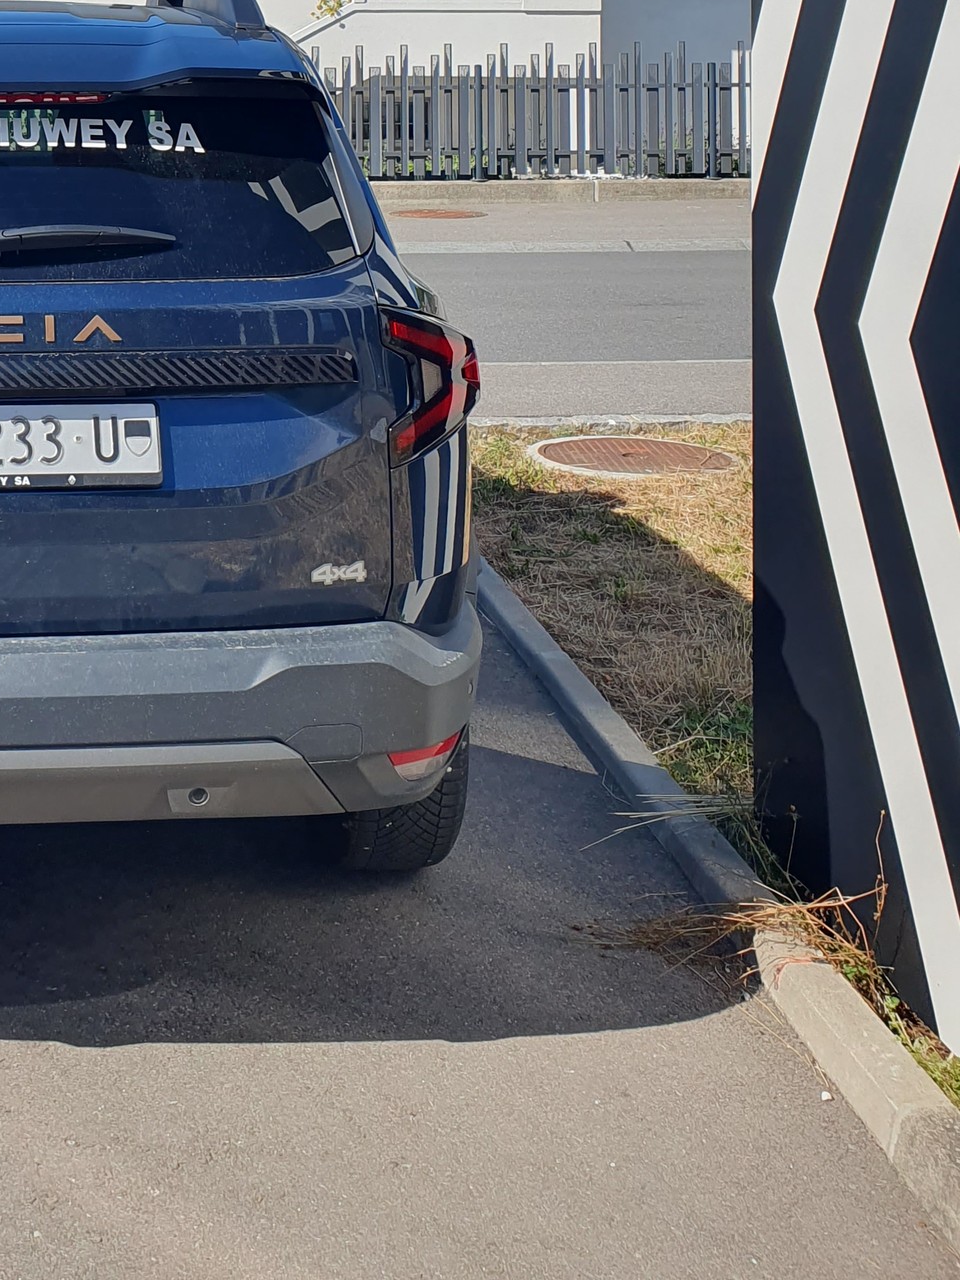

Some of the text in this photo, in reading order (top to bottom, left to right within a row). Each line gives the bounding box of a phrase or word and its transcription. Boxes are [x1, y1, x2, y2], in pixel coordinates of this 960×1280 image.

[147, 122, 206, 154] SA
[91, 414, 122, 464] U
[14, 476, 31, 486] SA
[311, 560, 368, 586] 4x4
